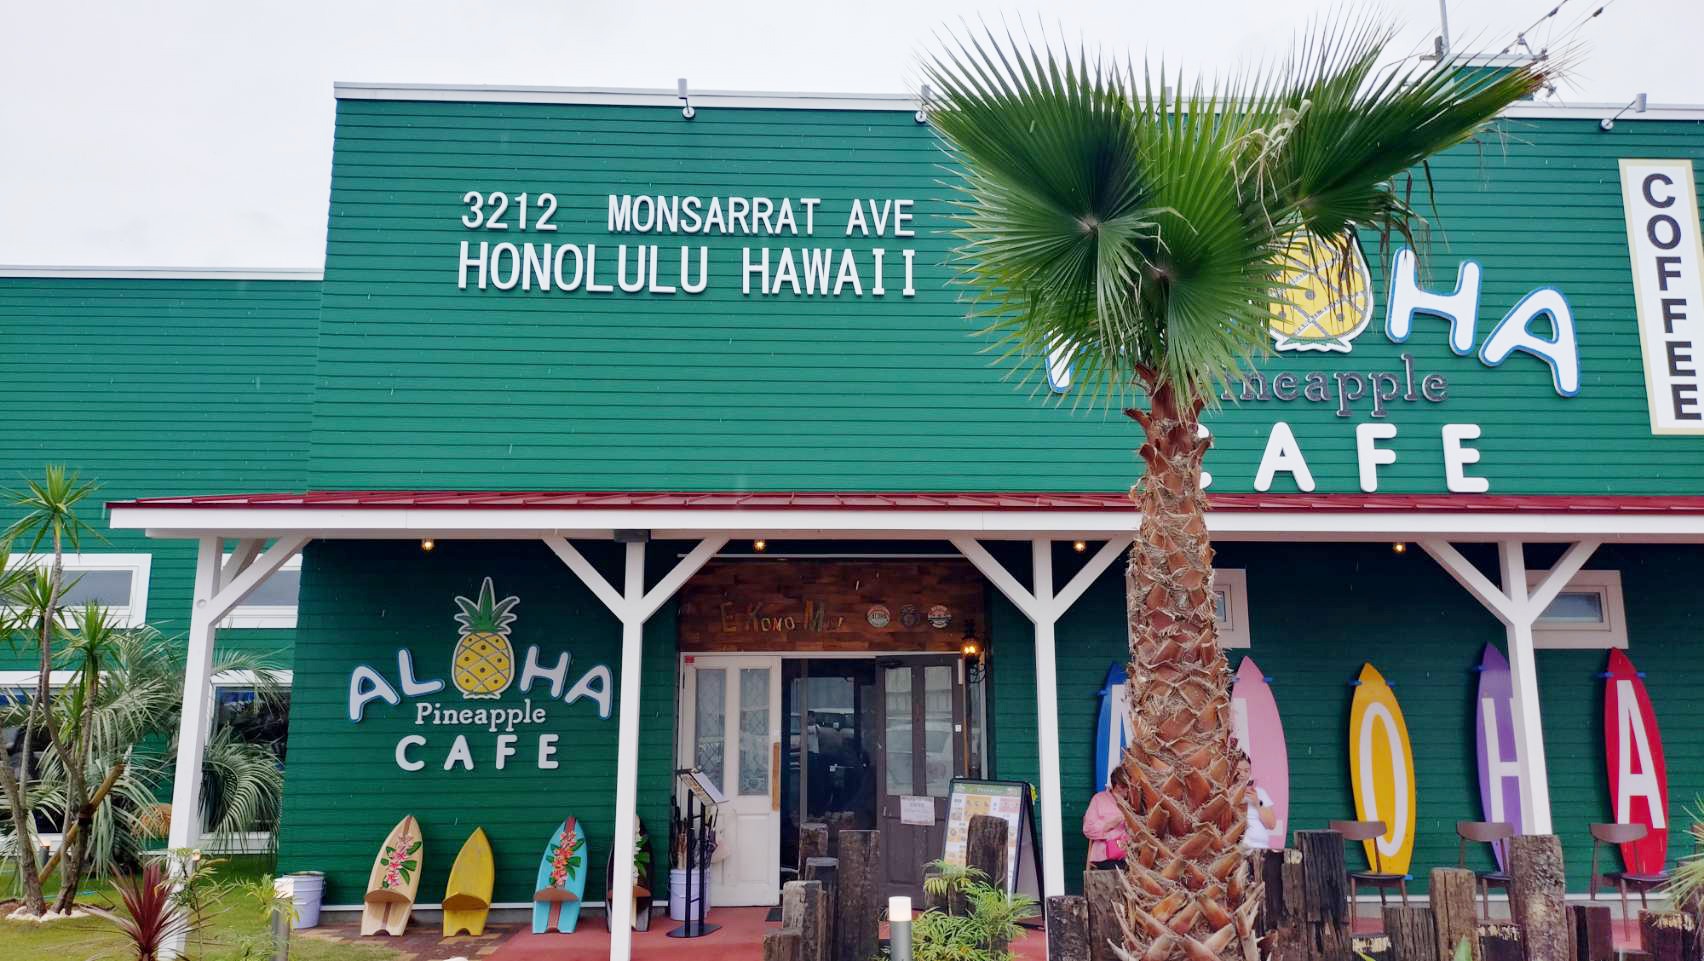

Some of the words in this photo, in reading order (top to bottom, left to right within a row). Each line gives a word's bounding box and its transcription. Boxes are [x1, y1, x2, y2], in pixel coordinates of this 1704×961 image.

[461, 191, 558, 231] 3212
[608, 194, 821, 235] MONSARRAT
[846, 199, 916, 237] AVE
[457, 240, 708, 294] HONOLULU
[742, 248, 916, 297] HAWAII
[1642, 173, 1702, 420] COFFEE
[1219, 353, 1450, 417] ineapple
[1198, 421, 1490, 493] AFE
[415, 699, 547, 732] Pineapple
[395, 733, 560, 772] CAFE
